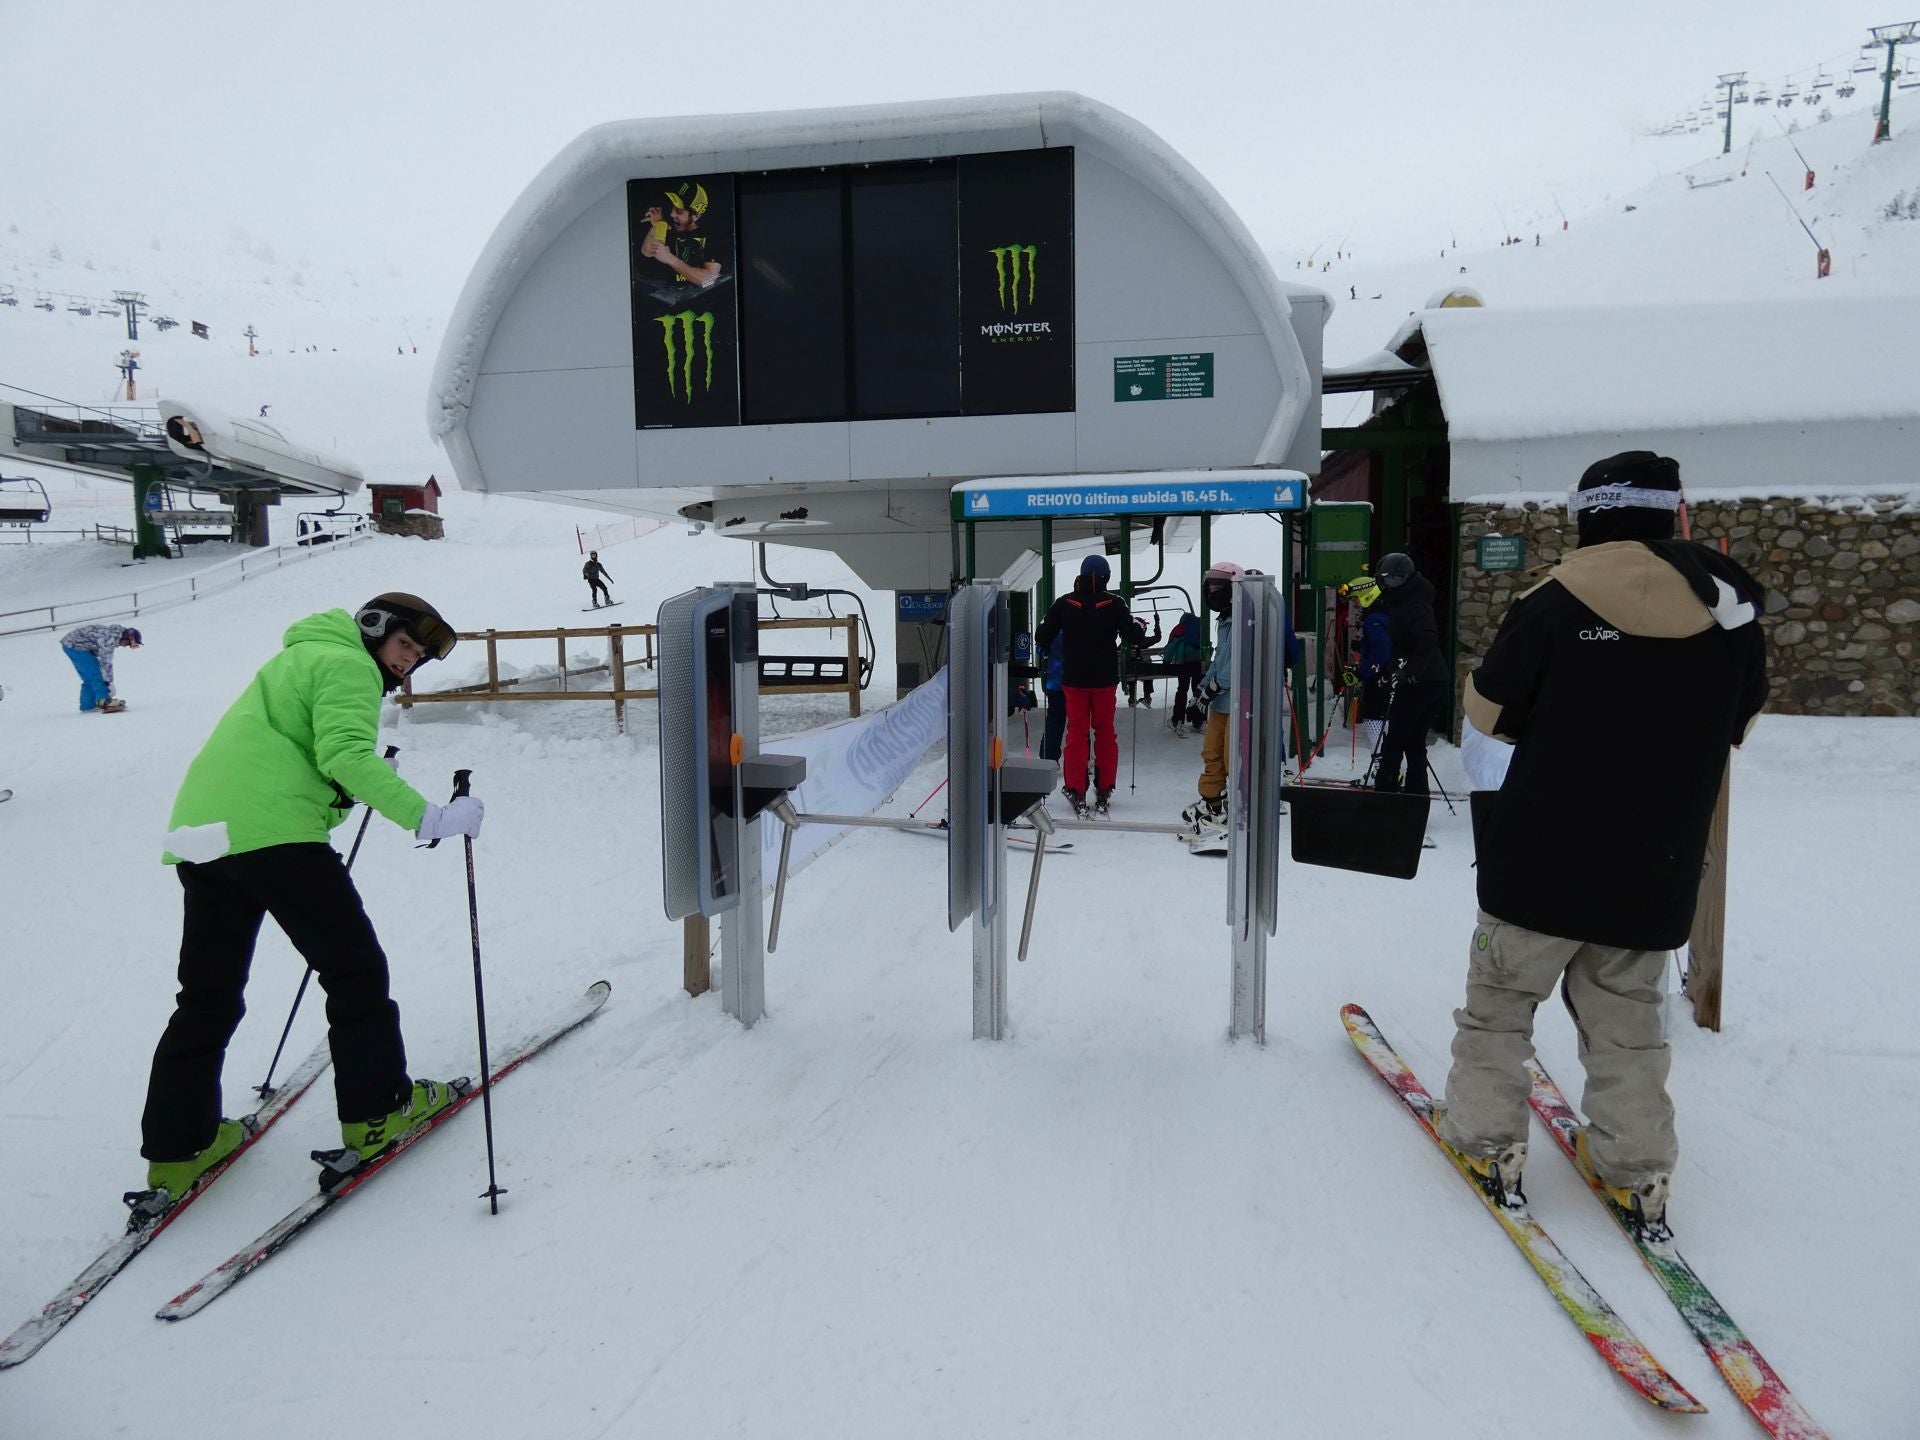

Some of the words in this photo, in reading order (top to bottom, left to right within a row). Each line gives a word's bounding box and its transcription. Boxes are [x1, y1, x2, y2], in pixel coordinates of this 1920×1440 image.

[981, 322, 1051, 336] MONSTER
[1027, 493, 1082, 506] REHOYO
[1085, 492, 1128, 505] última
[1131, 490, 1178, 504] subida
[1180, 489, 1217, 503] 16.45
[1220, 489, 1233, 502] h.
[1586, 492, 1622, 502] WEDZE
